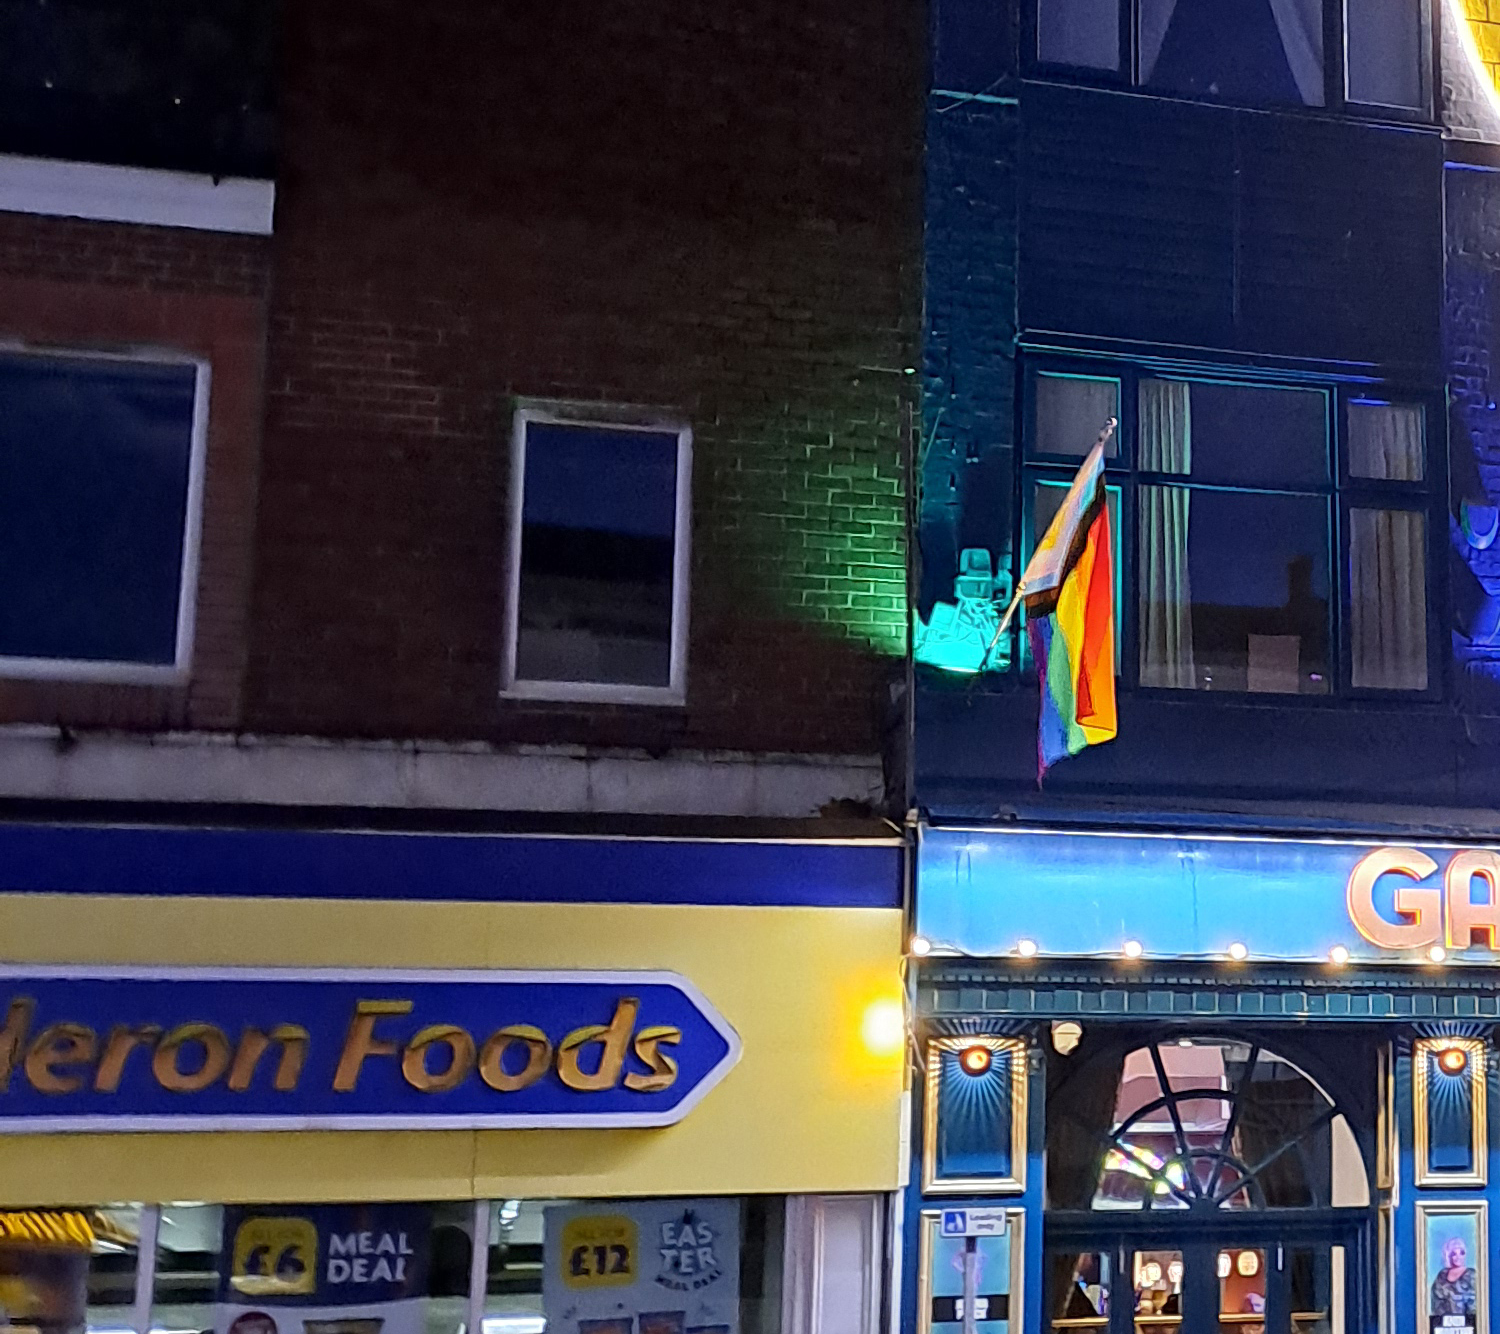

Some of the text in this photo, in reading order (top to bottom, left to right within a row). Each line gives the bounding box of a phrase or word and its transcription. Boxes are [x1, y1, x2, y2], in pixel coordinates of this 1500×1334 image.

[332, 998, 682, 1093] Foods
[328, 1231, 414, 1256] MEAL
[660, 1221, 713, 1247] EAS
[243, 1243, 306, 1284] £6
[326, 1257, 405, 1284] DEAL
[568, 1244, 630, 1276] £12
[660, 1246, 717, 1274] TER
